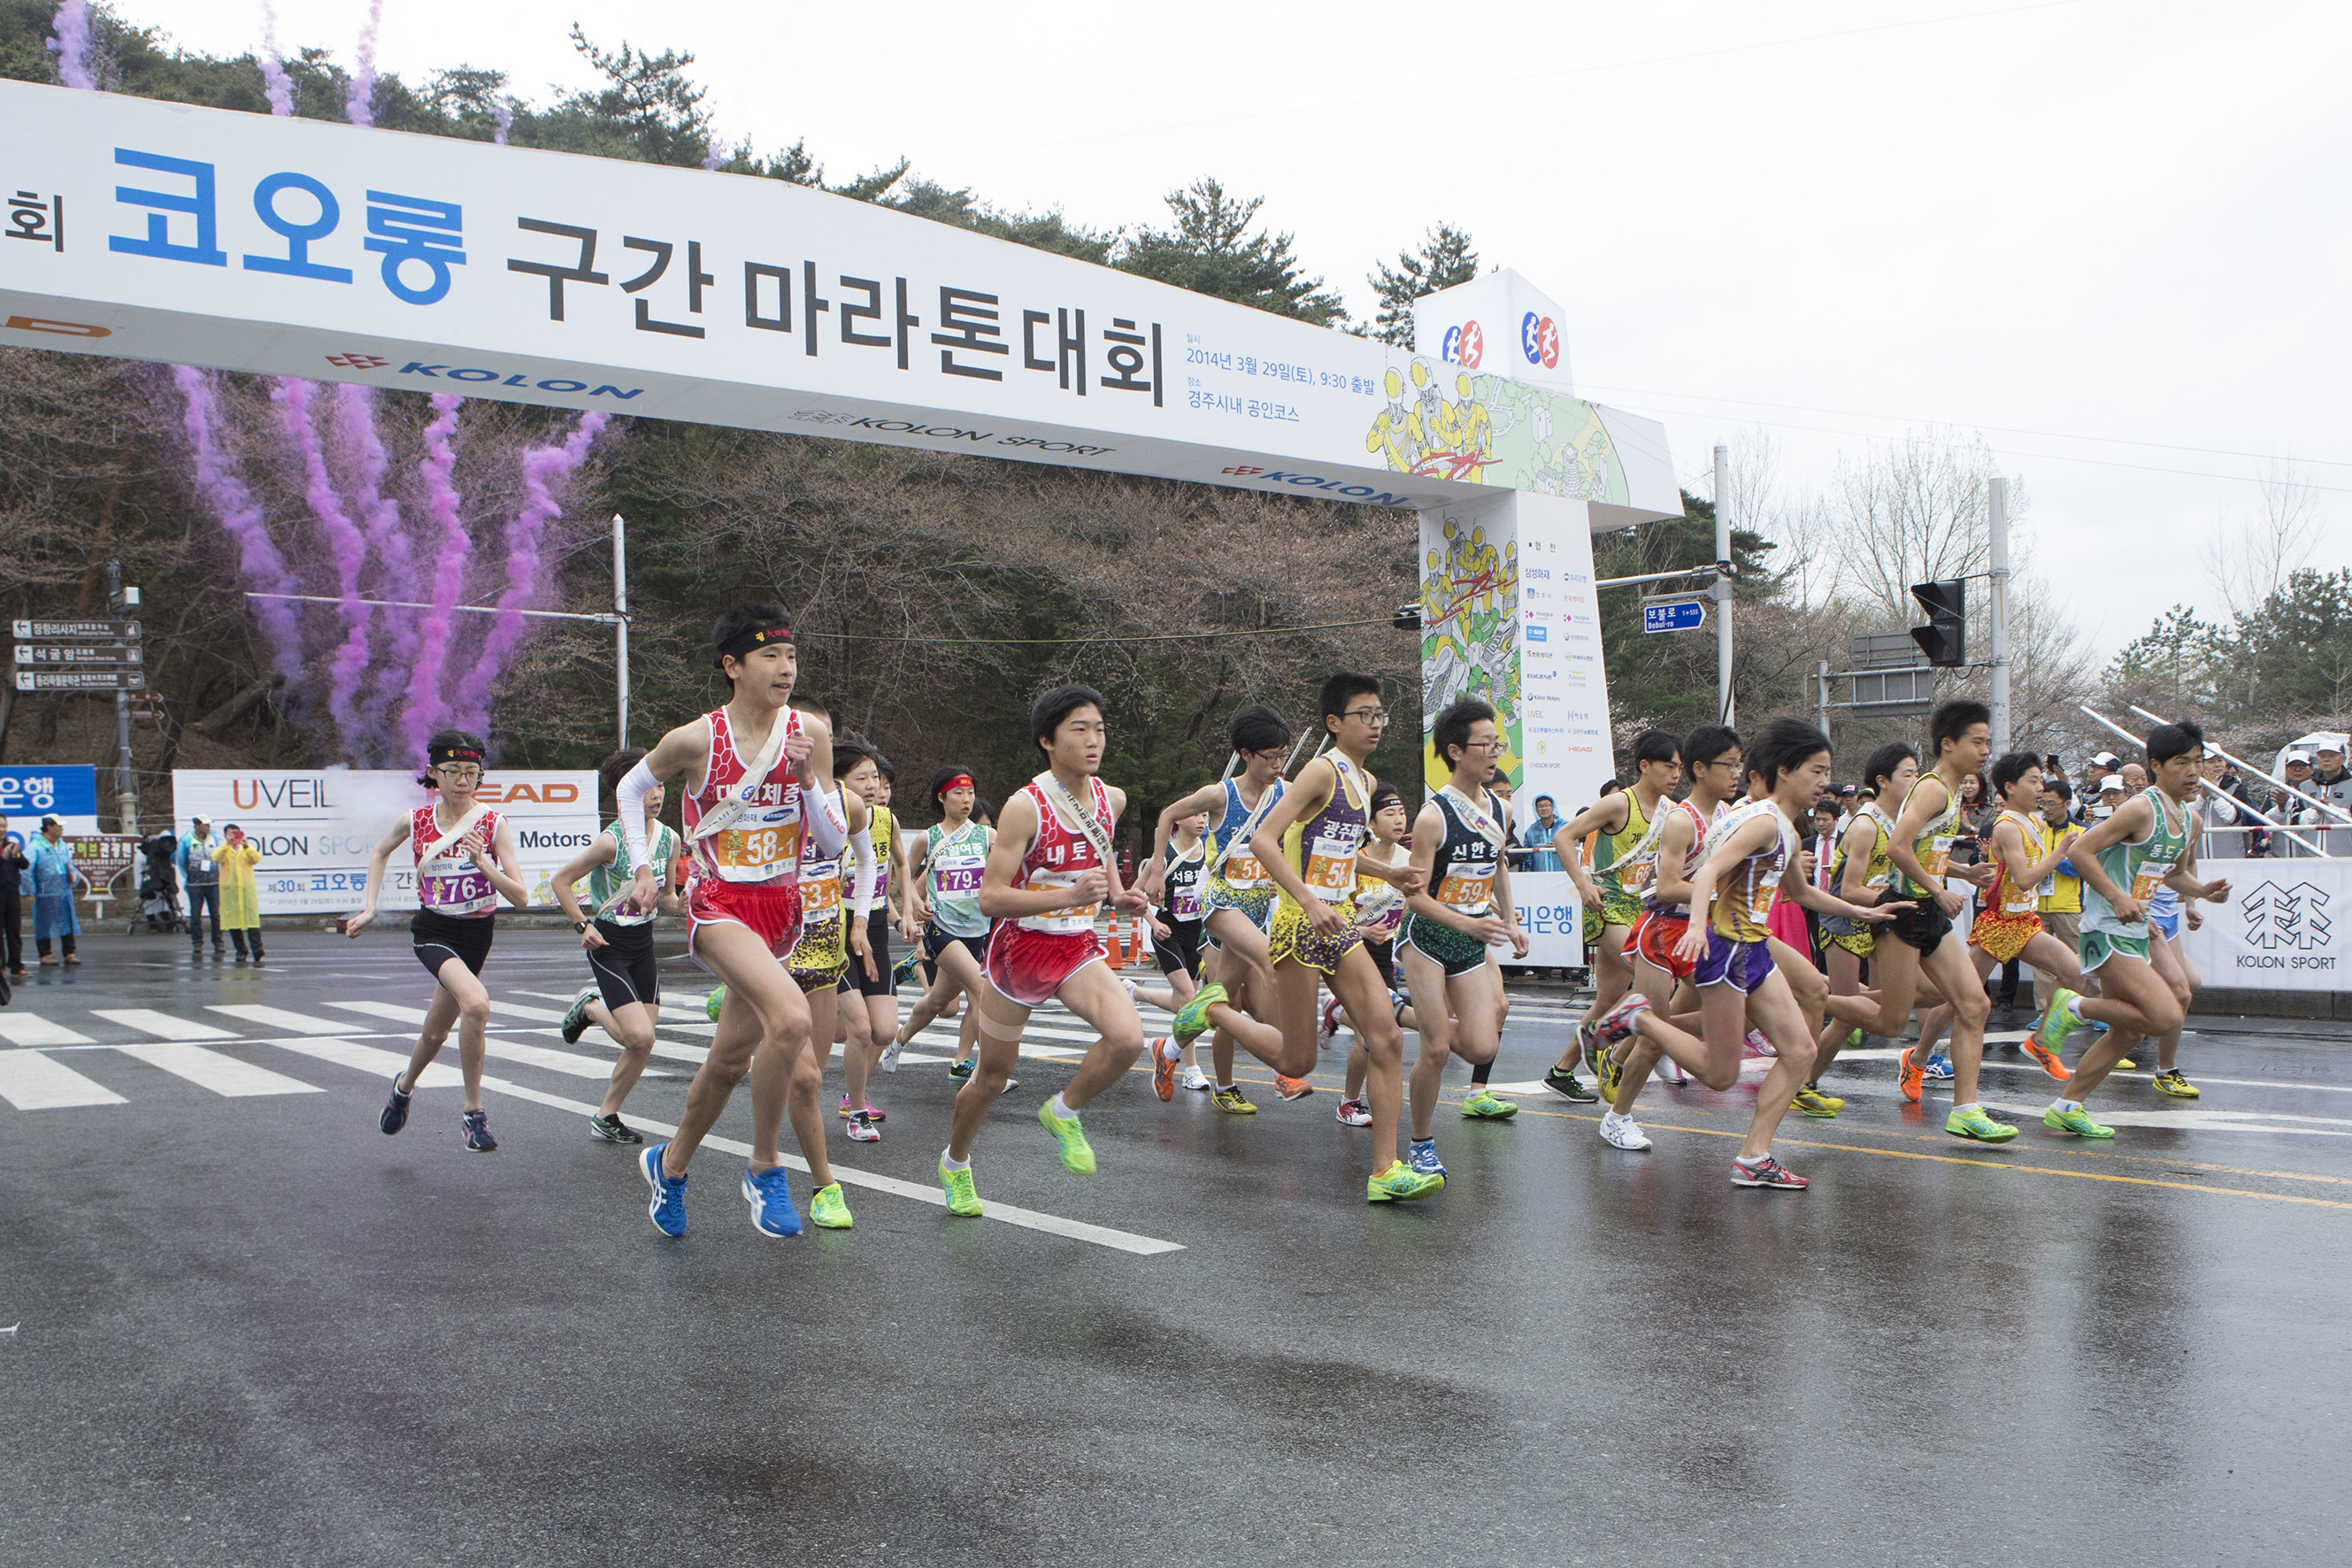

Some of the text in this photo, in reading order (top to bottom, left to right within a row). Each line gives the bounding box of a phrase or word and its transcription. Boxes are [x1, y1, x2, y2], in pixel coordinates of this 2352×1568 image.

[4, 147, 1163, 407] 회 코오롱 구간 마라톤대회
[1186, 334, 1200, 344] 일시
[398, 362, 645, 400] KOLON
[1187, 348, 1375, 396] 2014년 3월 29일(토), 9:30 출발
[1187, 377, 1202, 387] 장소
[1188, 390, 1300, 422] 경주시내 공인코스
[849, 417, 1117, 456] KOLON SPORT
[1258, 472, 1409, 505] KOLON
[1525, 568, 1550, 580] 삼성화재
[1648, 607, 1676, 621] 보불로
[1547, 693, 1560, 702] Motors
[0, 777, 54, 809] 은행
[234, 780, 341, 810] UVEIL
[520, 830, 592, 847] Motors
[747, 831, 794, 864] 58-1
[311, 873, 367, 892] 코오롱
[445, 876, 492, 903] 76-1
[1458, 882, 1489, 903] 59-1
[2237, 956, 2336, 970] KOLON SPORT
